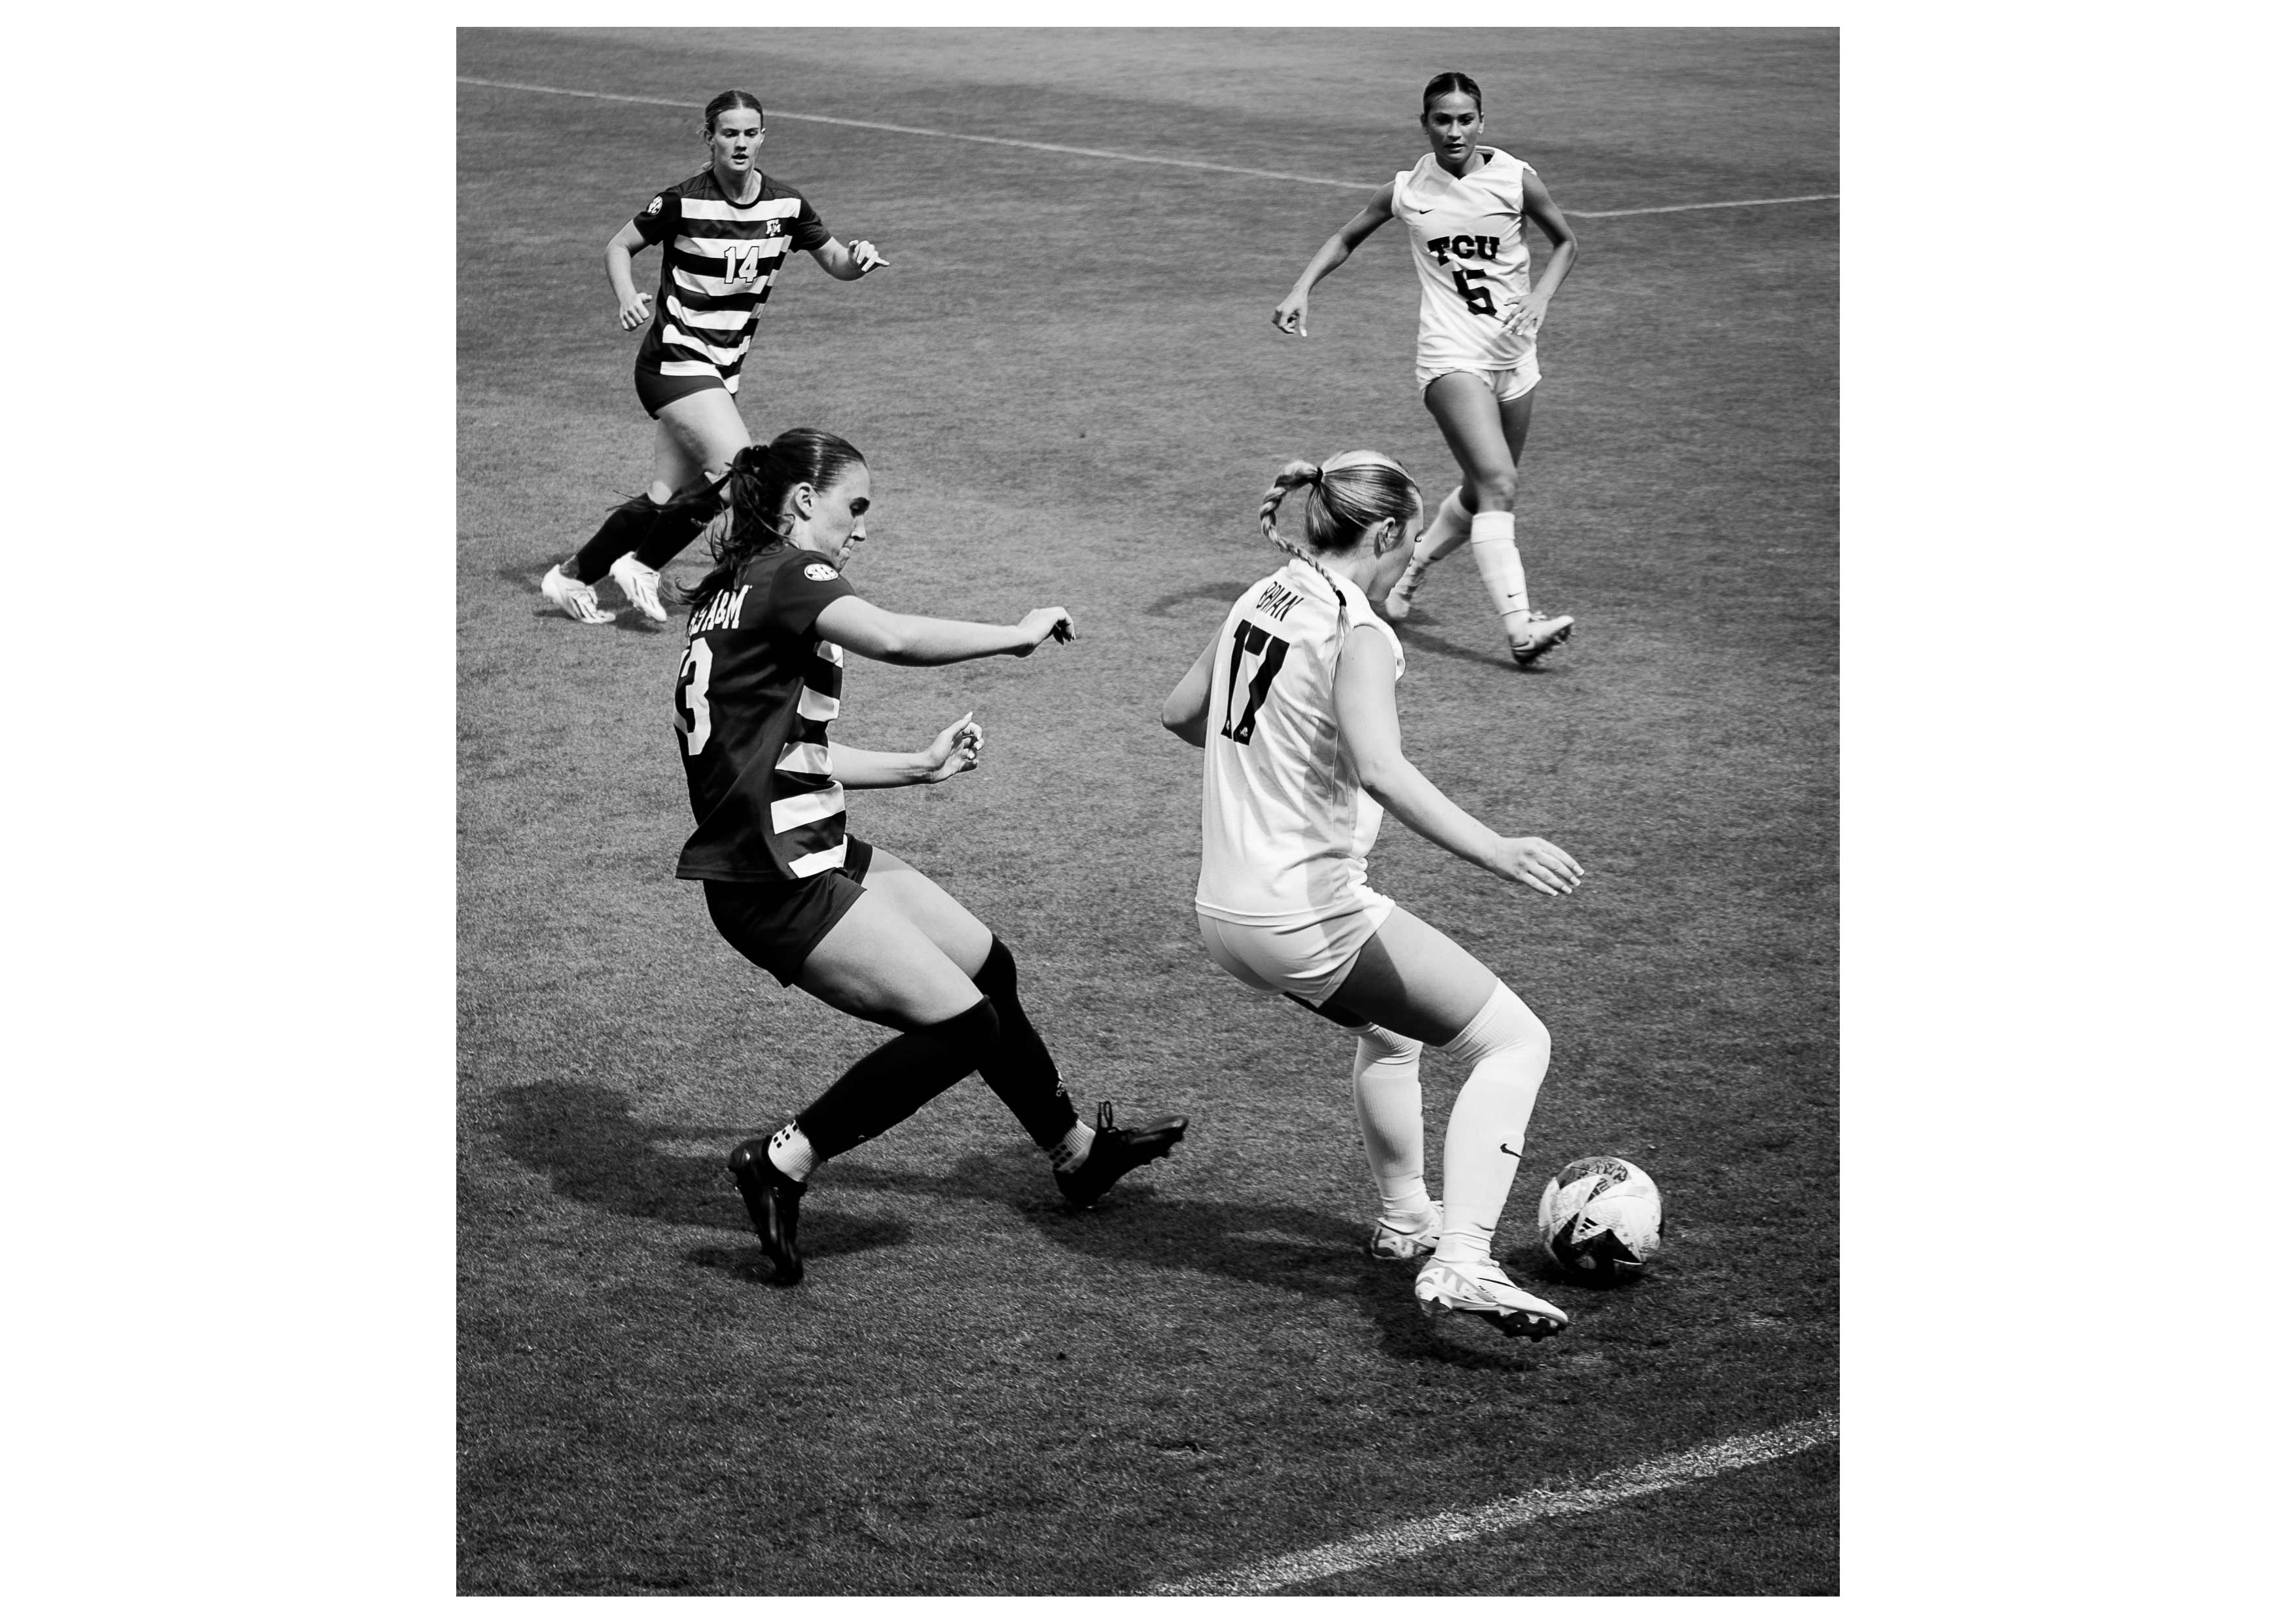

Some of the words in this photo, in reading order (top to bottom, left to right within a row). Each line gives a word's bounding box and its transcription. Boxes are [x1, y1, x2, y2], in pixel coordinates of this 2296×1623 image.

[724, 246, 759, 284] 14
[1427, 235, 1500, 266] TCU
[1452, 269, 1498, 316] 5
[1256, 581, 1304, 622] BRIAN
[1221, 619, 1290, 746] 17
